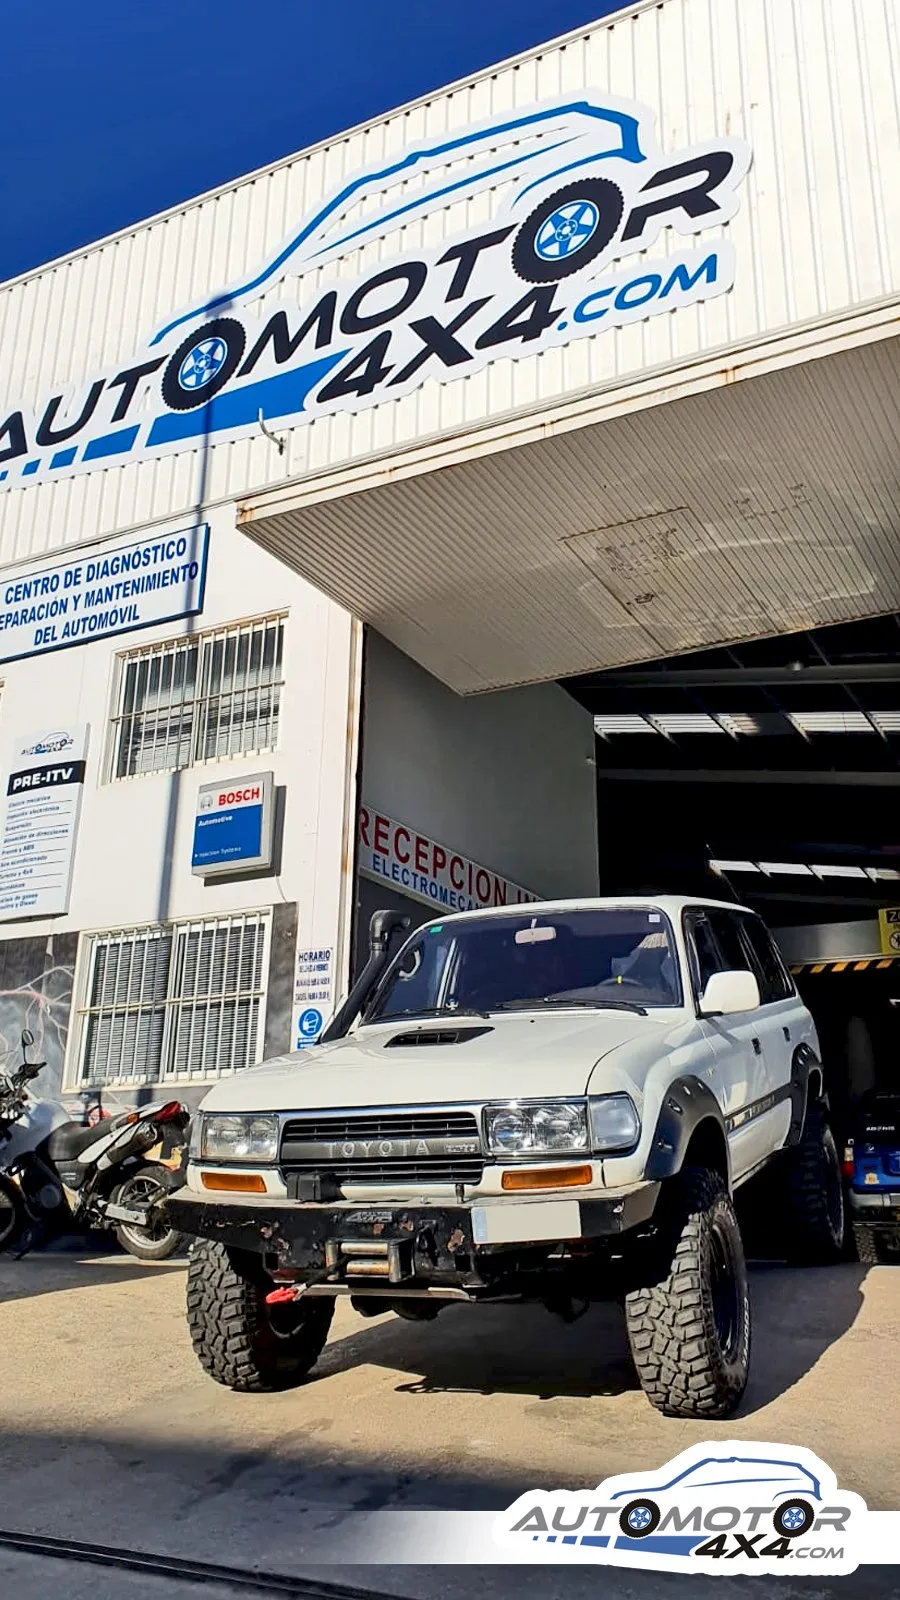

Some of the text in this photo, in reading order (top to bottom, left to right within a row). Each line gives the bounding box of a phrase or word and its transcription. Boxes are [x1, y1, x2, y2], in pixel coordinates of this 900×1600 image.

[0, 151, 734, 462] AUTOMOTOR
[5, 537, 186, 604] CENTRO DE DIAGNÓSTICO
[72, 594, 81, 611] Y
[84, 561, 198, 608] MANTENIMIENTO
[34, 604, 140, 645] DEL AUTOMÓVIL
[13, 767, 73, 791] PRE-ITV
[218, 787, 260, 806] BOSCH
[198, 815, 233, 827] Automotive
[360, 808, 507, 906] RECEPCION
[298, 950, 331, 962] HORARIO
[325, 1140, 430, 1158] TOYOTA
